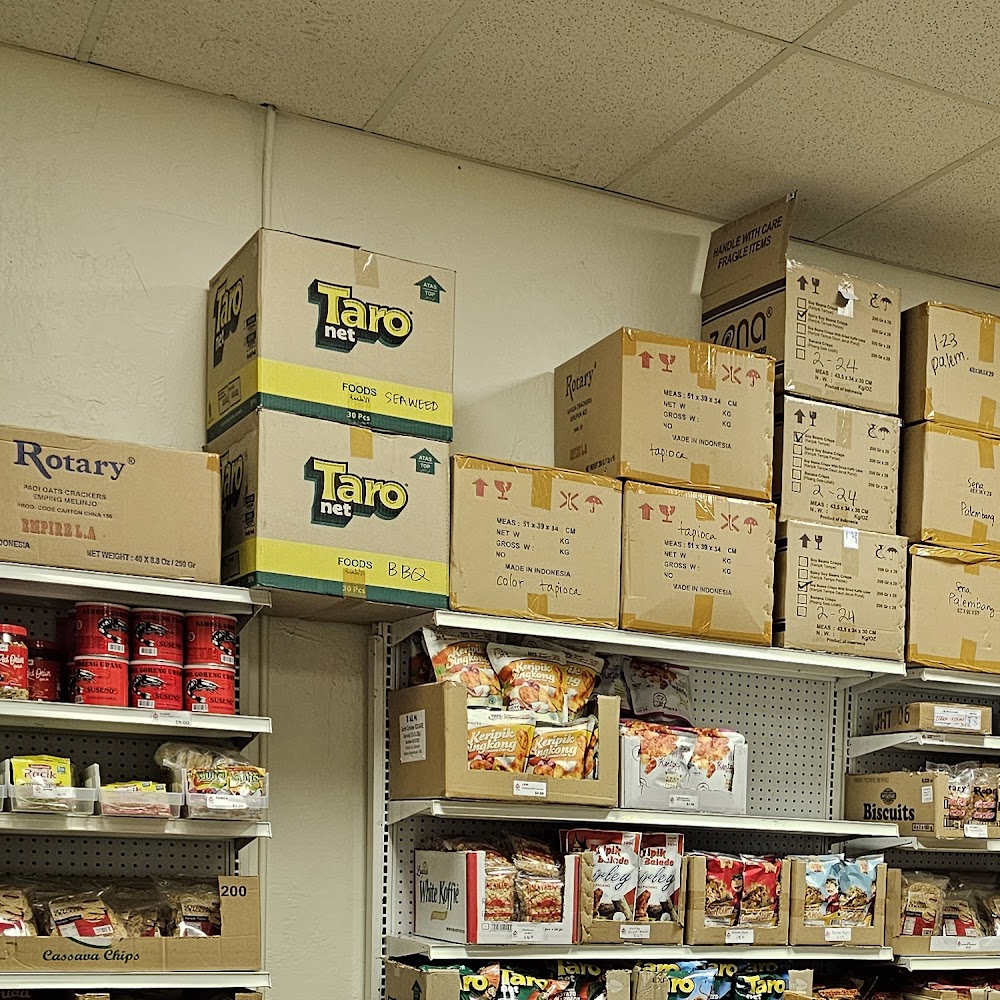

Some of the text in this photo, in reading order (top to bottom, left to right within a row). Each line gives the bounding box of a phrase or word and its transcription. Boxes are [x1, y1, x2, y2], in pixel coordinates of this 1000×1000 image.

[712, 216, 783, 259] HANDLE WITH CARE
[717, 235, 771, 269] FRAGILE ITEMS
[316, 281, 412, 337] Taro
[325, 324, 356, 343] net
[342, 382, 377, 396] FOODS
[385, 391, 438, 411] SEAWEED
[663, 411, 686, 420] GROSS
[672, 434, 690, 443] MADE
[699, 438, 732, 450] INDONESIA
[13, 440, 125, 480] Rotary
[649, 443, 688, 463] tapioca
[313, 459, 408, 510] Taro
[33, 494, 98, 507] EMPING MELINJO
[65, 489, 107, 501] CRACKERS
[320, 501, 351, 517] net
[21, 518, 73, 538] EMPIRE
[496, 517, 516, 527] MEAS
[678, 520, 717, 541] tapioca
[496, 540, 520, 549] GROSS
[102, 551, 129, 561] WEIGHT
[338, 557, 373, 570] FOODS
[505, 563, 525, 572] MADE
[535, 567, 571, 577] INDONESIA
[539, 579, 581, 598] tapioca
[673, 583, 691, 592] MADE
[700, 586, 732, 596] INDONESIA
[516, 662, 552, 673] Keripik
[875, 710, 892, 731] JHT
[472, 728, 515, 743] Keripik
[535, 734, 576, 750] Keripik
[863, 803, 915, 821] Biscuits
[644, 857, 675, 867] Balado
[220, 885, 247, 897] 200
[419, 879, 438, 904] White
[42, 949, 140, 964] Cassava Chips
[500, 969, 548, 990] Taro
[745, 975, 786, 994] Taro
